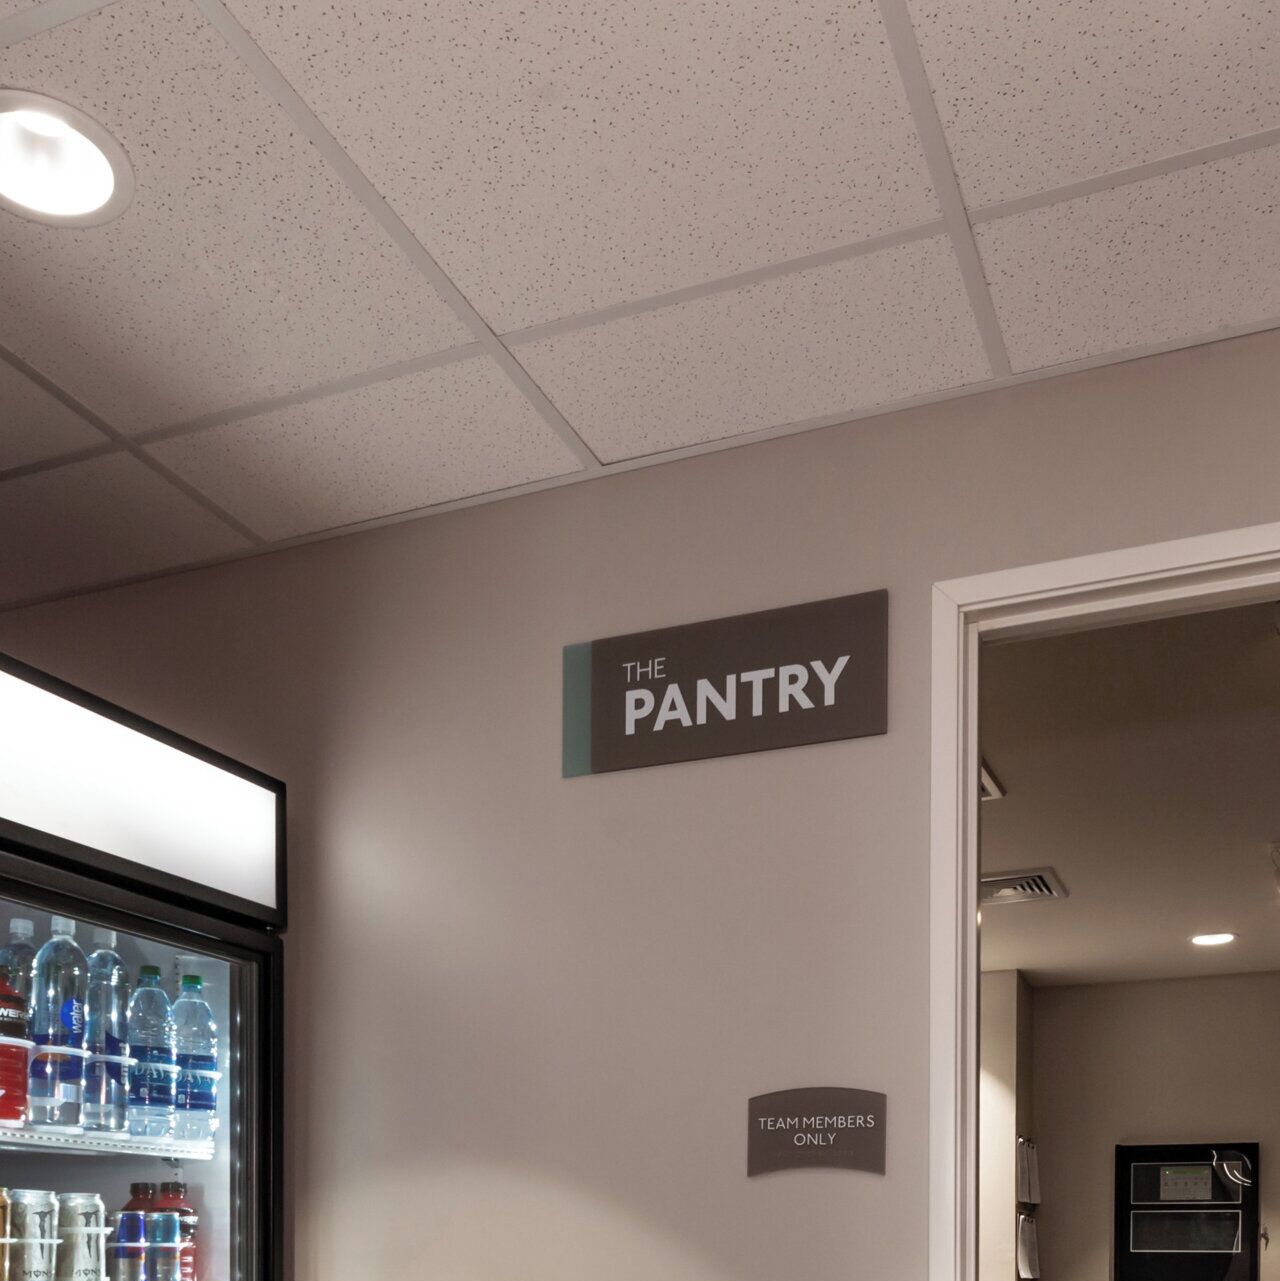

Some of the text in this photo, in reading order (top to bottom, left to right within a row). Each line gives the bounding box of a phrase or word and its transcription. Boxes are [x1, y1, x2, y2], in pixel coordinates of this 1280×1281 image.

[622, 658, 667, 683] THE
[625, 655, 851, 736] PANTRY
[69, 999, 83, 1034] water
[758, 1115, 875, 1130] TEAM MEMBERS
[794, 1133, 836, 1146] ONLY
